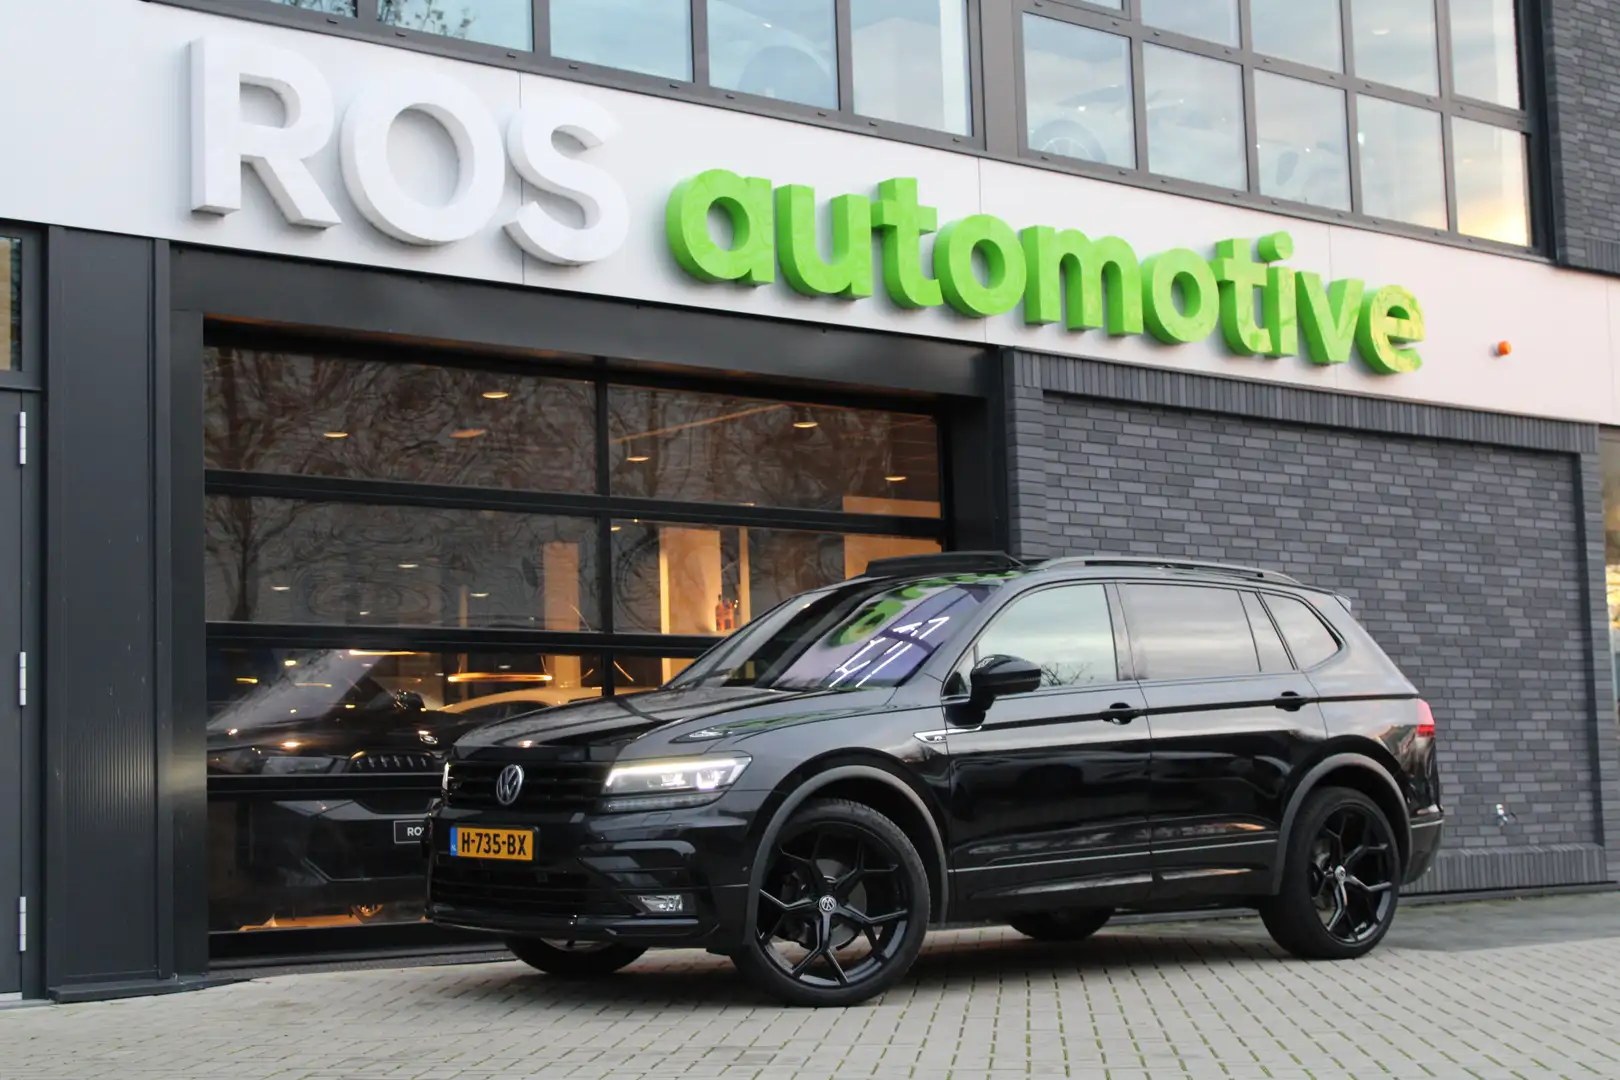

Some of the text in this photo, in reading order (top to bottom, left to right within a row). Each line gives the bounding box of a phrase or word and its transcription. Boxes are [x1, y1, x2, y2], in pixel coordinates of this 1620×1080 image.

[189, 34, 1424, 375] ROS automotive
[406, 826, 425, 837] RO
[461, 831, 527, 856] H-735-BX
